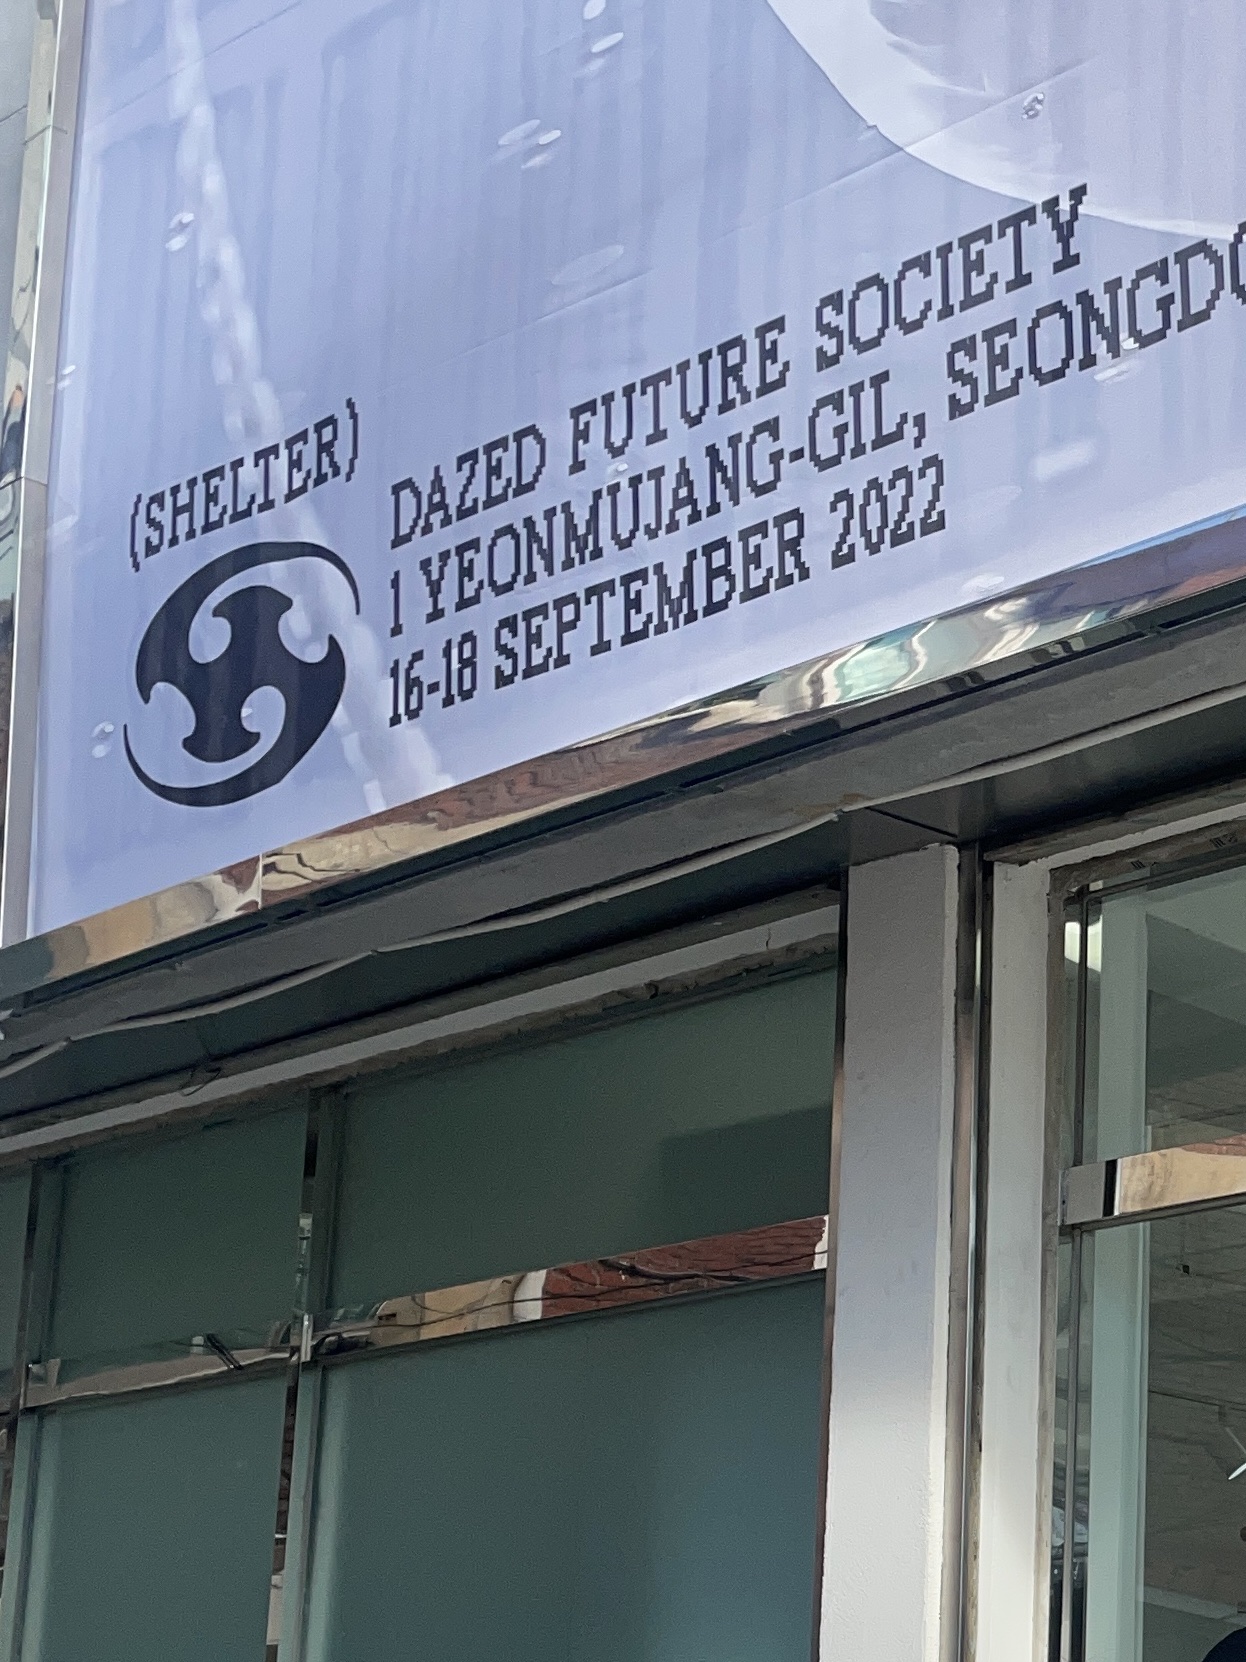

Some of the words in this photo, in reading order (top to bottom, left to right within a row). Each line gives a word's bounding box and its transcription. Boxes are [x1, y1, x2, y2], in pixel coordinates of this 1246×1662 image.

[130, 396, 359, 573] (SHELTER)
[390, 423, 546, 549] DAZED
[569, 315, 790, 474] FUTURE
[815, 182, 1088, 373] SOCIETY
[419, 369, 926, 624] YEONMUJANG-GIL,
[389, 629, 477, 727] 16-18
[494, 507, 810, 690] SEPTEMBER
[829, 453, 946, 570] 2022
